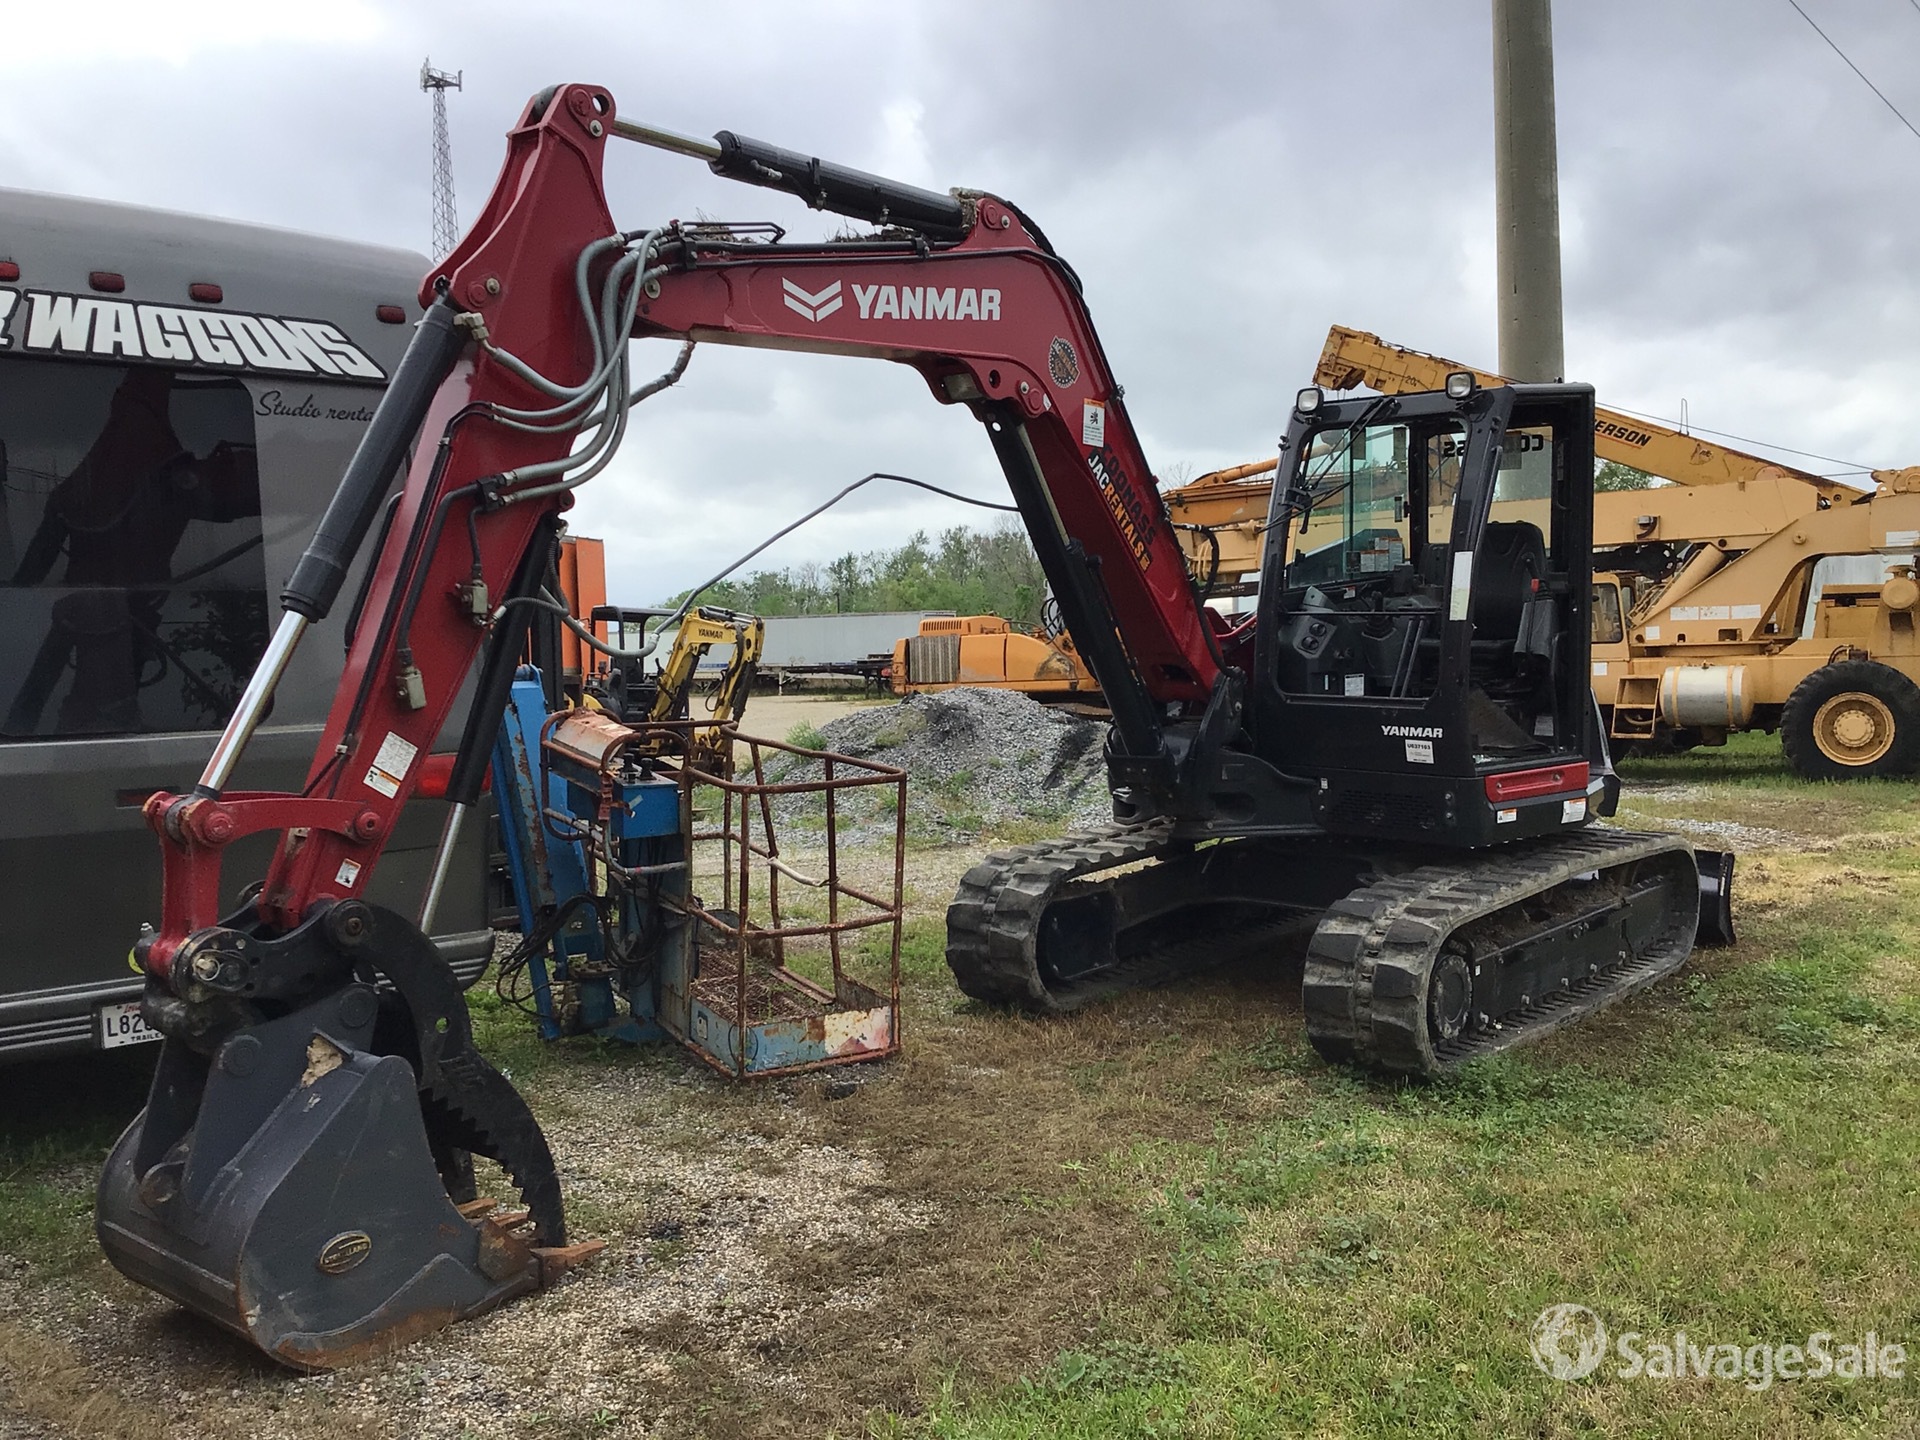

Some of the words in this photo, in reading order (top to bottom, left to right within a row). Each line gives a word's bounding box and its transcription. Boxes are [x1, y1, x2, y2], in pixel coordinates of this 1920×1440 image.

[851, 284, 1002, 321] YANMAR
[27, 292, 389, 379] WAGGONS
[256, 390, 322, 418] Studio
[325, 406, 374, 422] renta
[1594, 418, 1651, 447] ERSON
[698, 628, 724, 639] YANMAR
[1381, 725, 1443, 738] YANMAR
[131, 1032, 162, 1042] TRAILE
